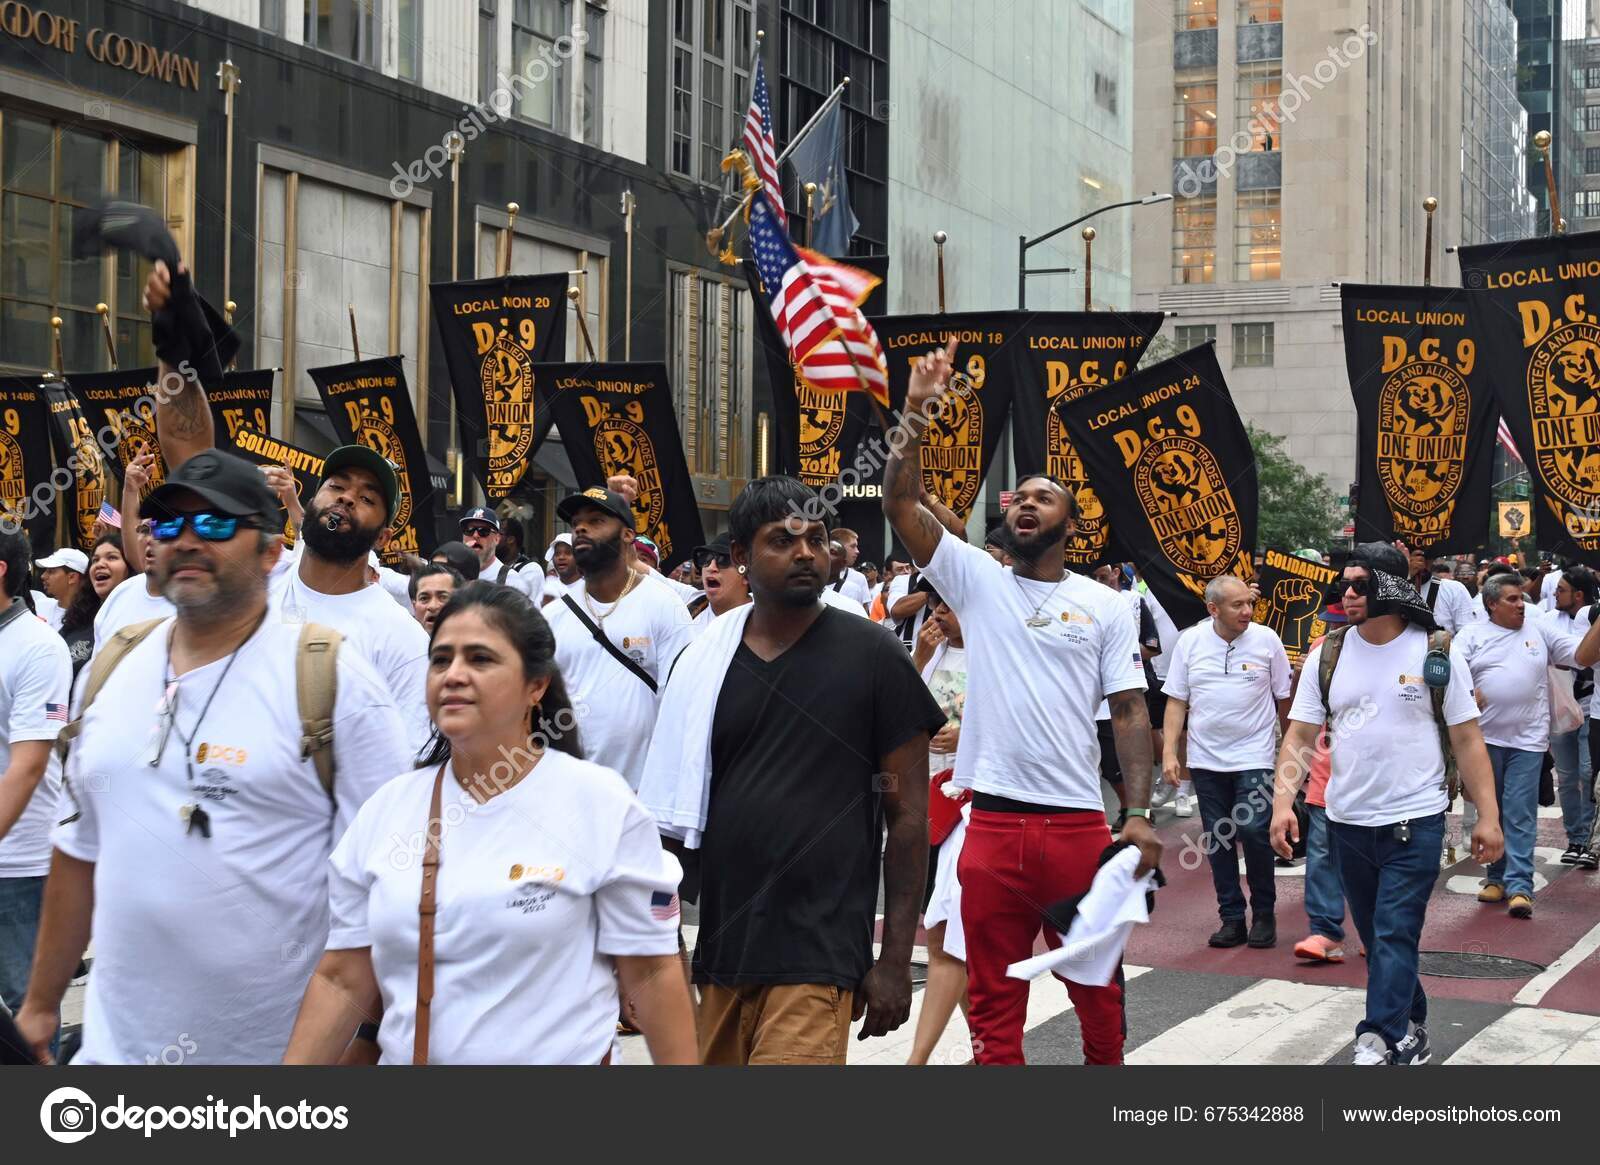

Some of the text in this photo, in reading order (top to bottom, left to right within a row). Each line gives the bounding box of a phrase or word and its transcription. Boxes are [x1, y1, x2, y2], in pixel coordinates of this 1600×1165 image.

[86, 28, 199, 91] GOODMAN
[1487, 267, 1553, 289] LOCAL
[454, 299, 499, 315] LOCAL
[535, 297, 550, 308] 20
[1357, 309, 1465, 326] LOCAL UNION
[888, 331, 1002, 349] LOCAL UNION 18
[1029, 336, 1078, 349] LOCAL
[1082, 335, 1125, 350] UNION
[485, 357, 497, 400] PAINTERS
[521, 362, 532, 400] TRADES
[1532, 350, 1552, 414] PAINTERS
[1548, 328, 1575, 352] AND
[11, 391, 36, 401] 1486
[86, 389, 118, 400] LOCAL
[209, 390, 230, 401] OCAL
[327, 381, 357, 396] LOCAL
[1087, 375, 1201, 431] LOCAL UNION 24
[1381, 365, 1467, 432] PAINTERS AND ALLIED TRADES
[362, 418, 391, 435] ALLIED
[822, 415, 844, 450] UNION
[968, 399, 979, 442] TRADES
[1050, 387, 1085, 452] PAINTE AND
[1537, 417, 1577, 447] ONE
[236, 430, 326, 478] SOLIDARITY!
[512, 426, 531, 457] UNION
[603, 421, 637, 436] ALLIED
[635, 430, 654, 468] TRADES
[1381, 434, 1462, 459] ONE UNION
[8, 445, 22, 477] TRADES
[799, 446, 840, 474] York
[1051, 457, 1077, 478] ONE
[956, 473, 975, 506] UNION
[1136, 440, 1222, 513] PAINTERS AND ALLIED TRADES
[1440, 465, 1458, 500] UNION
[1152, 491, 1233, 539] ONE UNION
